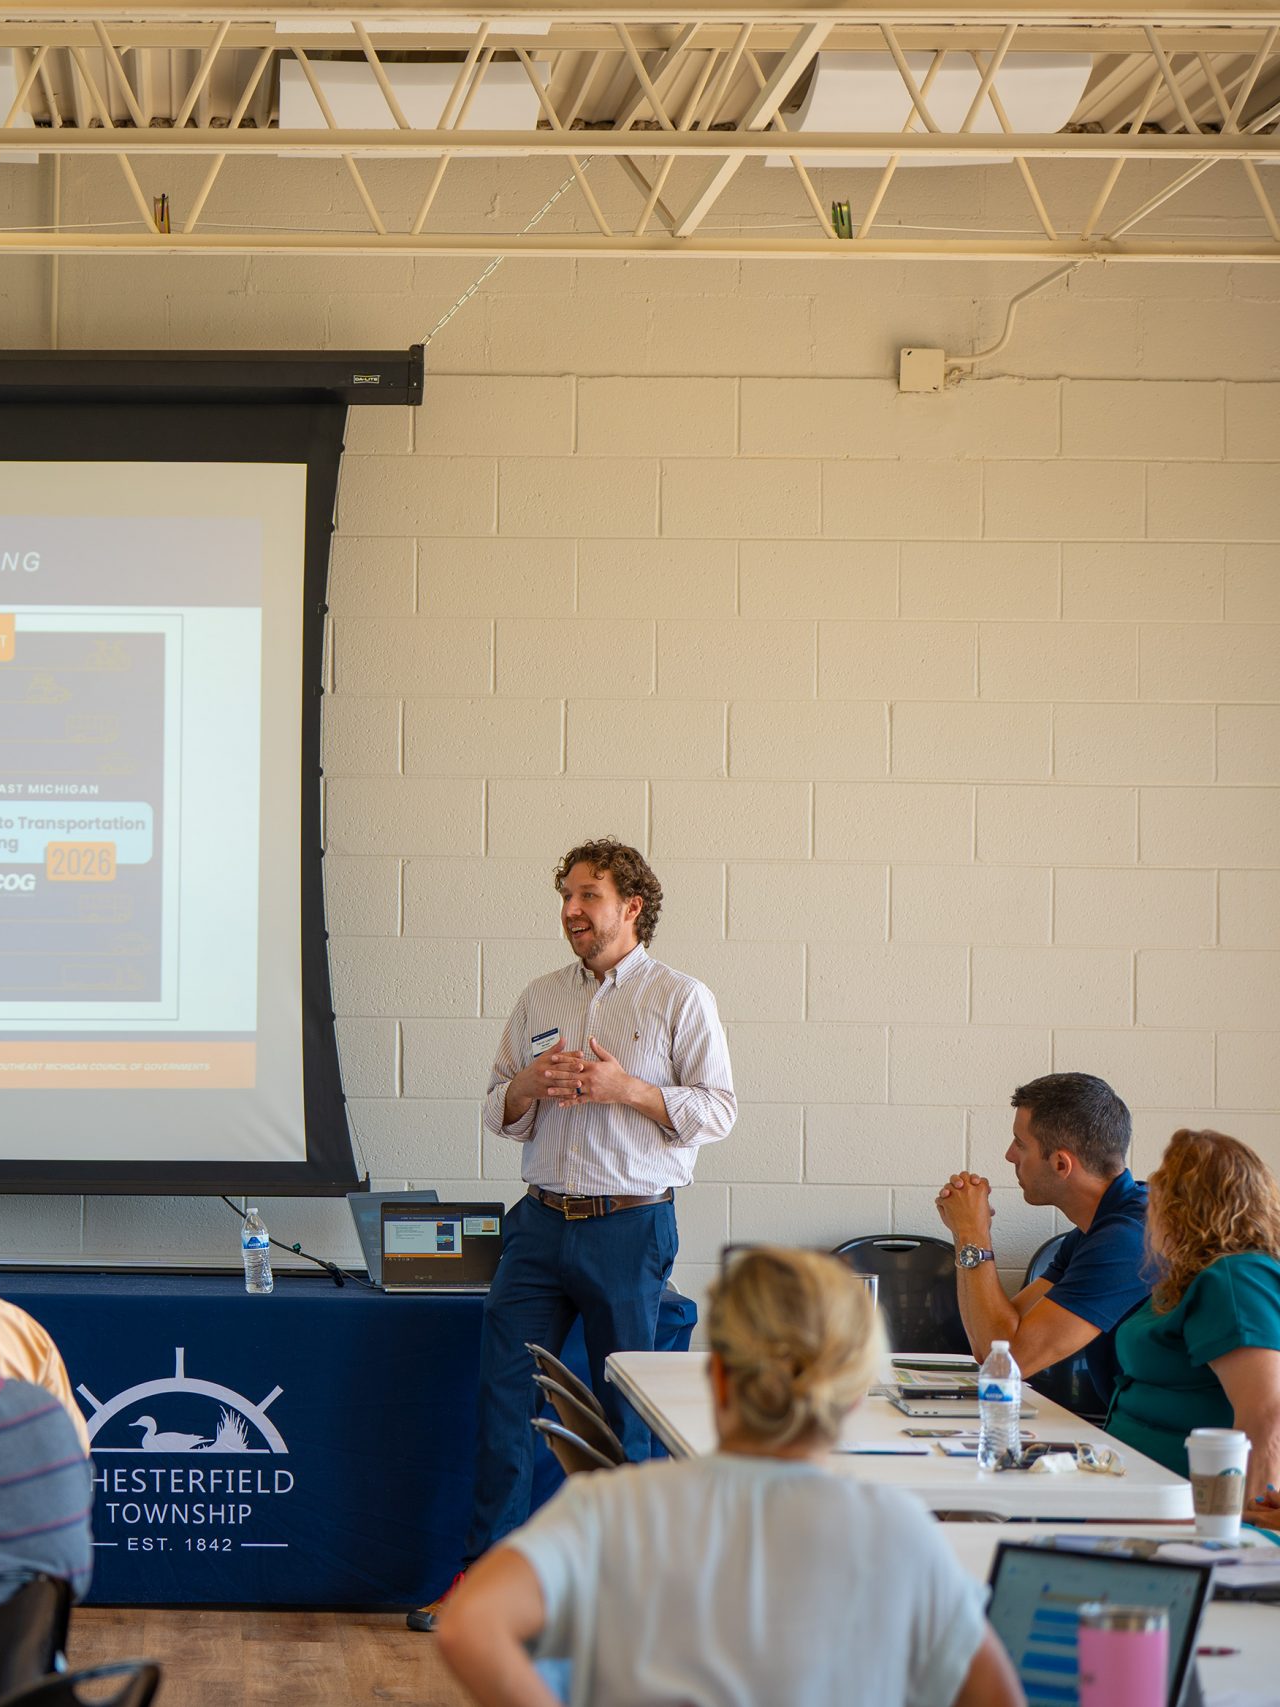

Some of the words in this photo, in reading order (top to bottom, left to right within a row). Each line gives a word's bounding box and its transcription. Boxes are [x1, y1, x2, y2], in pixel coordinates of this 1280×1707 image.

[28, 784, 100, 795] MICHIGAN
[18, 816, 146, 834] Transportation
[51, 848, 112, 876] 2026
[44, 1062, 89, 1071] MICHIGAN
[90, 1062, 128, 1071] COUNCIL
[130, 1062, 143, 1071] OF
[144, 1062, 210, 1071] GOVERNMENTS
[90, 1468, 294, 1494] HESTERFIELD
[106, 1503, 252, 1524] TOWNSHIP
[127, 1537, 173, 1551] EST.
[185, 1538, 232, 1552] 1842
